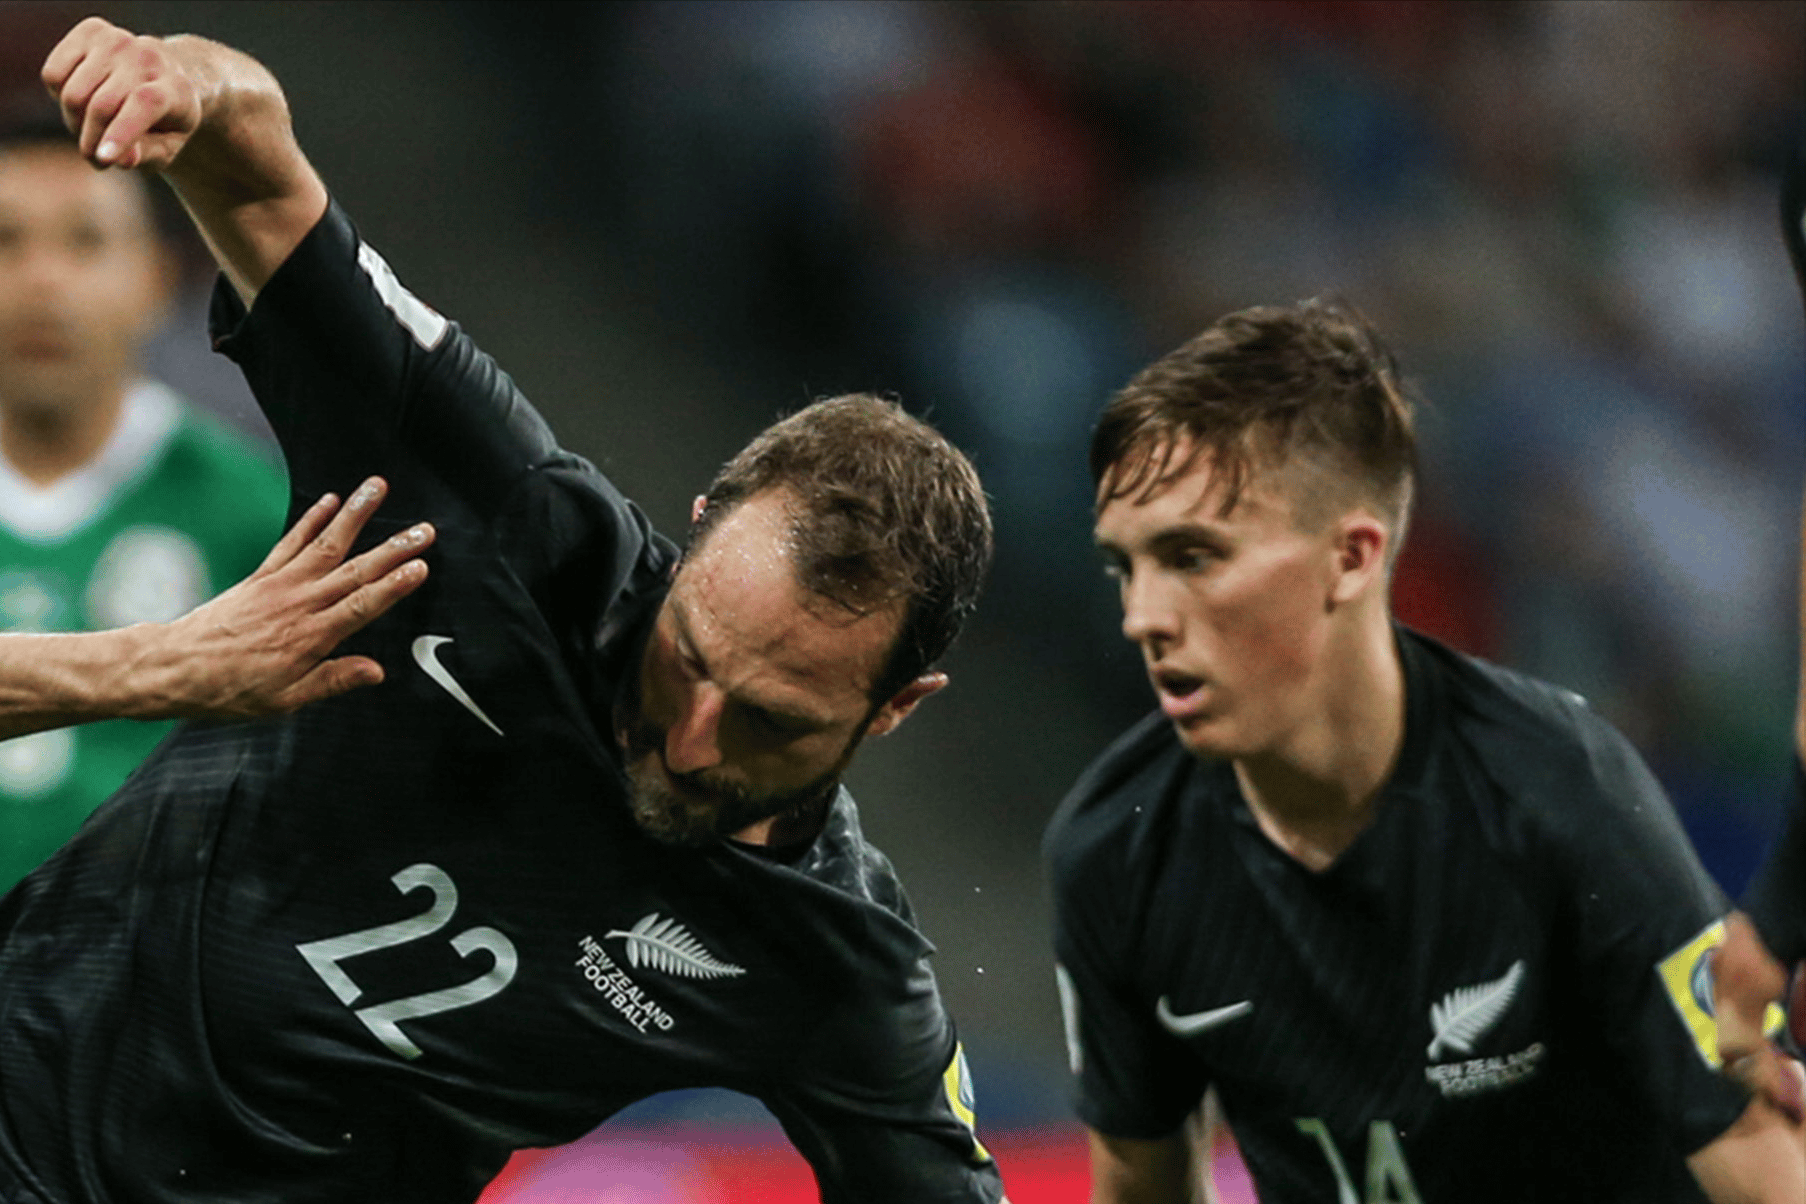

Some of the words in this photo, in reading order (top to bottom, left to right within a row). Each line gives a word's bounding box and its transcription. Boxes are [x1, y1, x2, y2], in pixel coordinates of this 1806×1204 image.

[295, 862, 518, 1058] 22
[575, 955, 650, 1034] FOOTBALL
[578, 936, 615, 970] NEW
[608, 967, 674, 1030] ZEALAND
[1424, 1063, 1463, 1082] NEW
